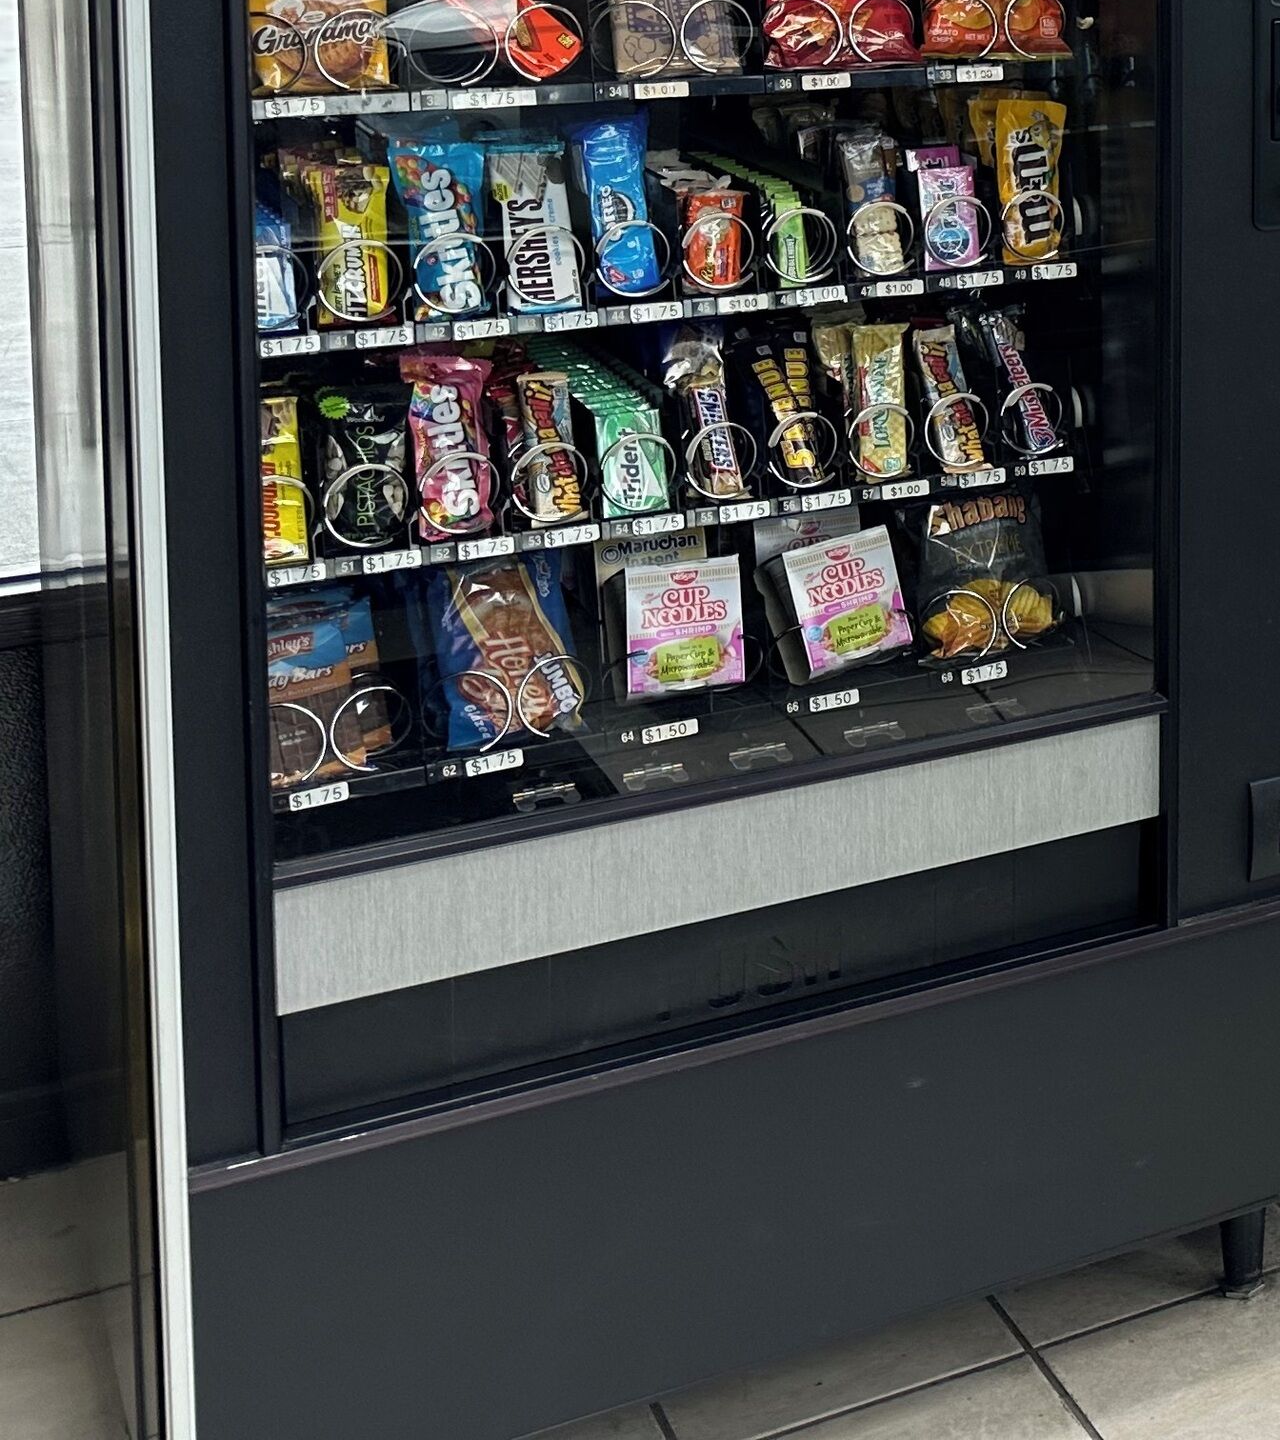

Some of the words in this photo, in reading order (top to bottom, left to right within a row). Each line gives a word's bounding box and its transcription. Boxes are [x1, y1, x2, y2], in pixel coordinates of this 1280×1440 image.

[608, 86, 622, 97] 34
[779, 78, 792, 89] 36
[811, 77, 840, 88] $1.00
[269, 99, 320, 116] $1.75
[958, 273, 999, 289] $1.75
[1014, 269, 1027, 280] 49
[1033, 264, 1073, 280] $1.75
[780, 295, 792, 305] 46
[799, 287, 840, 303] $1.00
[861, 286, 872, 297] 47
[885, 283, 913, 294] $1.00
[729, 297, 758, 309] $1.00
[546, 314, 594, 329] $1.75
[611, 310, 625, 321] 44
[633, 305, 679, 323] $1.75
[357, 329, 409, 348] $1.75
[432, 327, 445, 337] 42
[456, 321, 505, 339] $1.75
[262, 338, 315, 355] $1.75
[426, 383, 482, 517] Skittles
[618, 427, 644, 509] Trident
[1014, 466, 1026, 477] 59
[1030, 460, 1070, 475] $1.75
[961, 473, 1002, 487] $1.75
[862, 490, 874, 499] 57
[890, 484, 921, 497] $1.00
[783, 501, 796, 511] 56
[804, 492, 847, 510] $1.75
[701, 511, 713, 522] 55
[721, 503, 766, 521] $1.75
[615, 523, 629, 535] 54
[634, 517, 680, 534] $1.75
[528, 535, 542, 546] 53
[546, 526, 594, 546] $1.75
[618, 532, 698, 556] Maruchan
[436, 547, 450, 559] 52
[460, 540, 509, 560] $1.75
[341, 561, 354, 572] 51
[365, 553, 416, 573] $1.75
[820, 558, 866, 583] CUP
[270, 565, 321, 586] $1.75
[661, 586, 710, 609] CUP
[807, 570, 886, 608] NOODLES
[840, 593, 875, 610] SHRIMP
[641, 600, 727, 629] NOODLES
[674, 624, 713, 636] SHRIMP
[292, 665, 333, 683] Bars
[965, 662, 1004, 683] $1.75
[786, 701, 799, 713] 66
[812, 692, 852, 711] $1.50
[620, 731, 634, 744] 64
[644, 722, 688, 742] $1.50
[442, 764, 458, 777] 62
[471, 752, 517, 775] $1.75
[292, 786, 343, 809] $1.75
